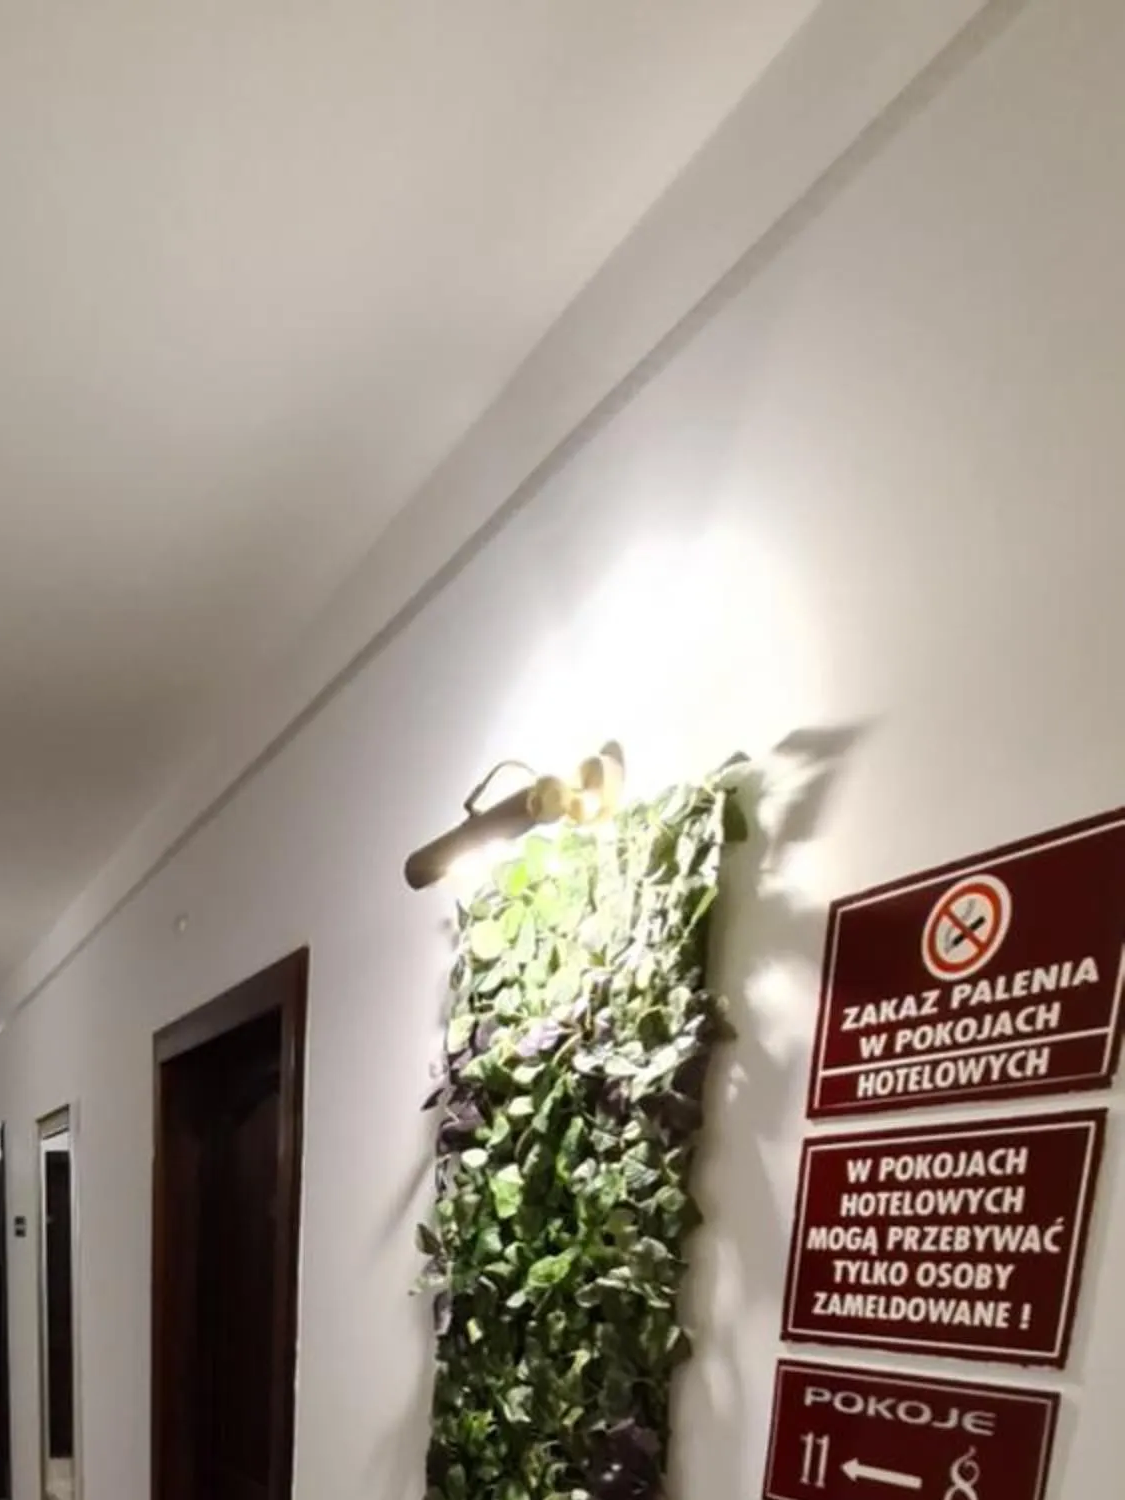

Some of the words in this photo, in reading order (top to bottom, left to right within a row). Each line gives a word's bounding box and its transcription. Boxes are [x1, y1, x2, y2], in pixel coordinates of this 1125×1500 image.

[841, 990, 940, 1031] ZAKAZ
[950, 956, 1099, 1009] PALENIA
[859, 1035, 885, 1059] W
[895, 1002, 1061, 1053] POKOJACH
[857, 1048, 1050, 1098] HOTELOWYCH
[847, 1159, 872, 1184] W
[879, 1147, 1028, 1182] POKOJACH
[840, 1186, 1025, 1217] HOTELOWYCH
[806, 1227, 878, 1256] MOGĄ
[887, 1217, 1065, 1252] PRZEBYWAĆ
[833, 1260, 908, 1285] TYLKO
[916, 1262, 1015, 1290] OSOBY
[812, 1292, 1012, 1329] ZAMELDOWANE
[804, 1386, 997, 1436] POKOJE
[800, 1432, 830, 1488] 11
